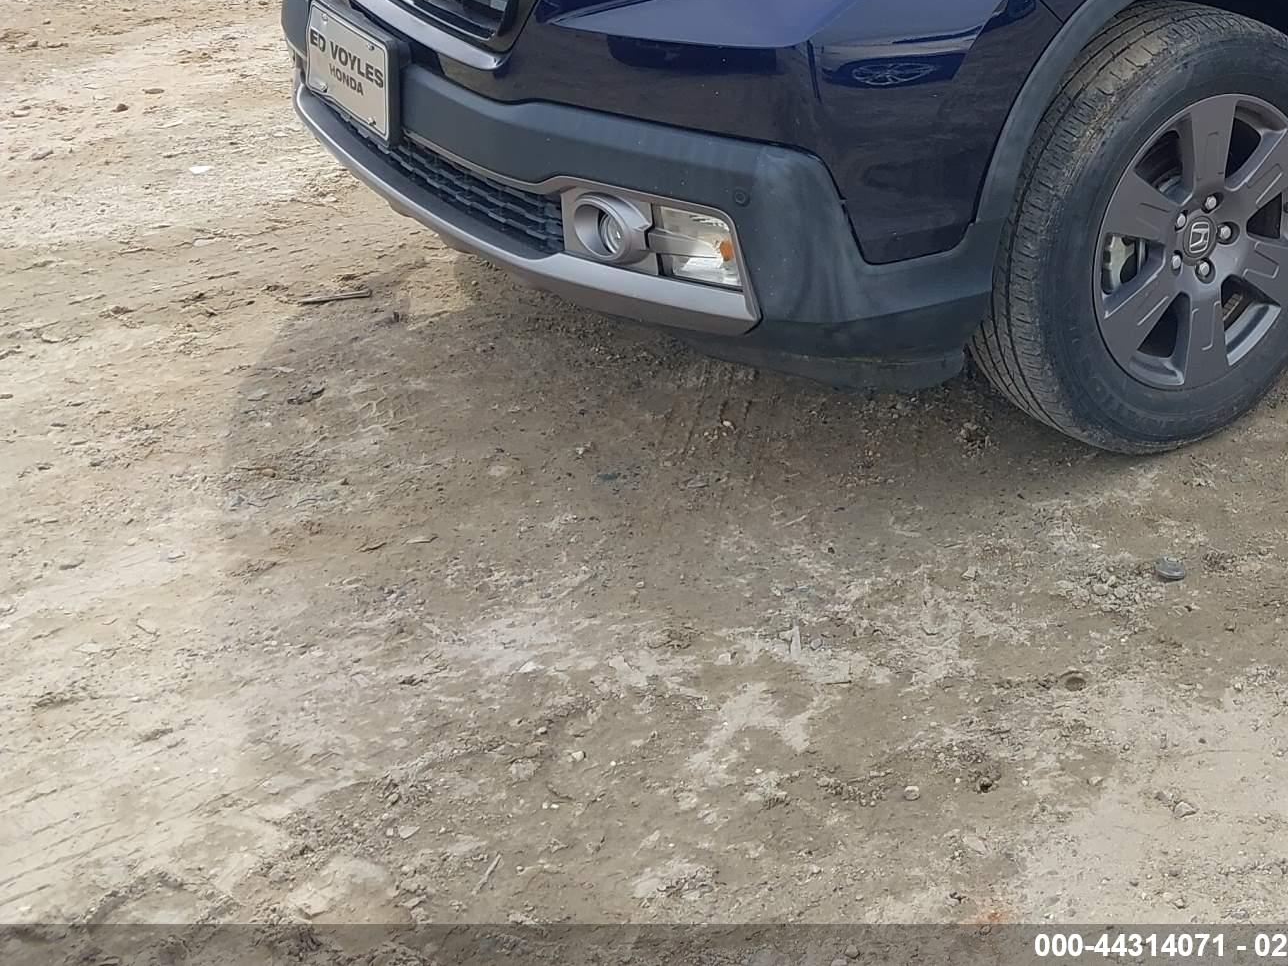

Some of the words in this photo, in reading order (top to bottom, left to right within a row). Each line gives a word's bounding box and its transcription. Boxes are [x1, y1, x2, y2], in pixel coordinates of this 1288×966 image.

[310, 29, 326, 53] ED
[330, 41, 384, 89] VOYLES
[329, 63, 364, 96] HONDA
